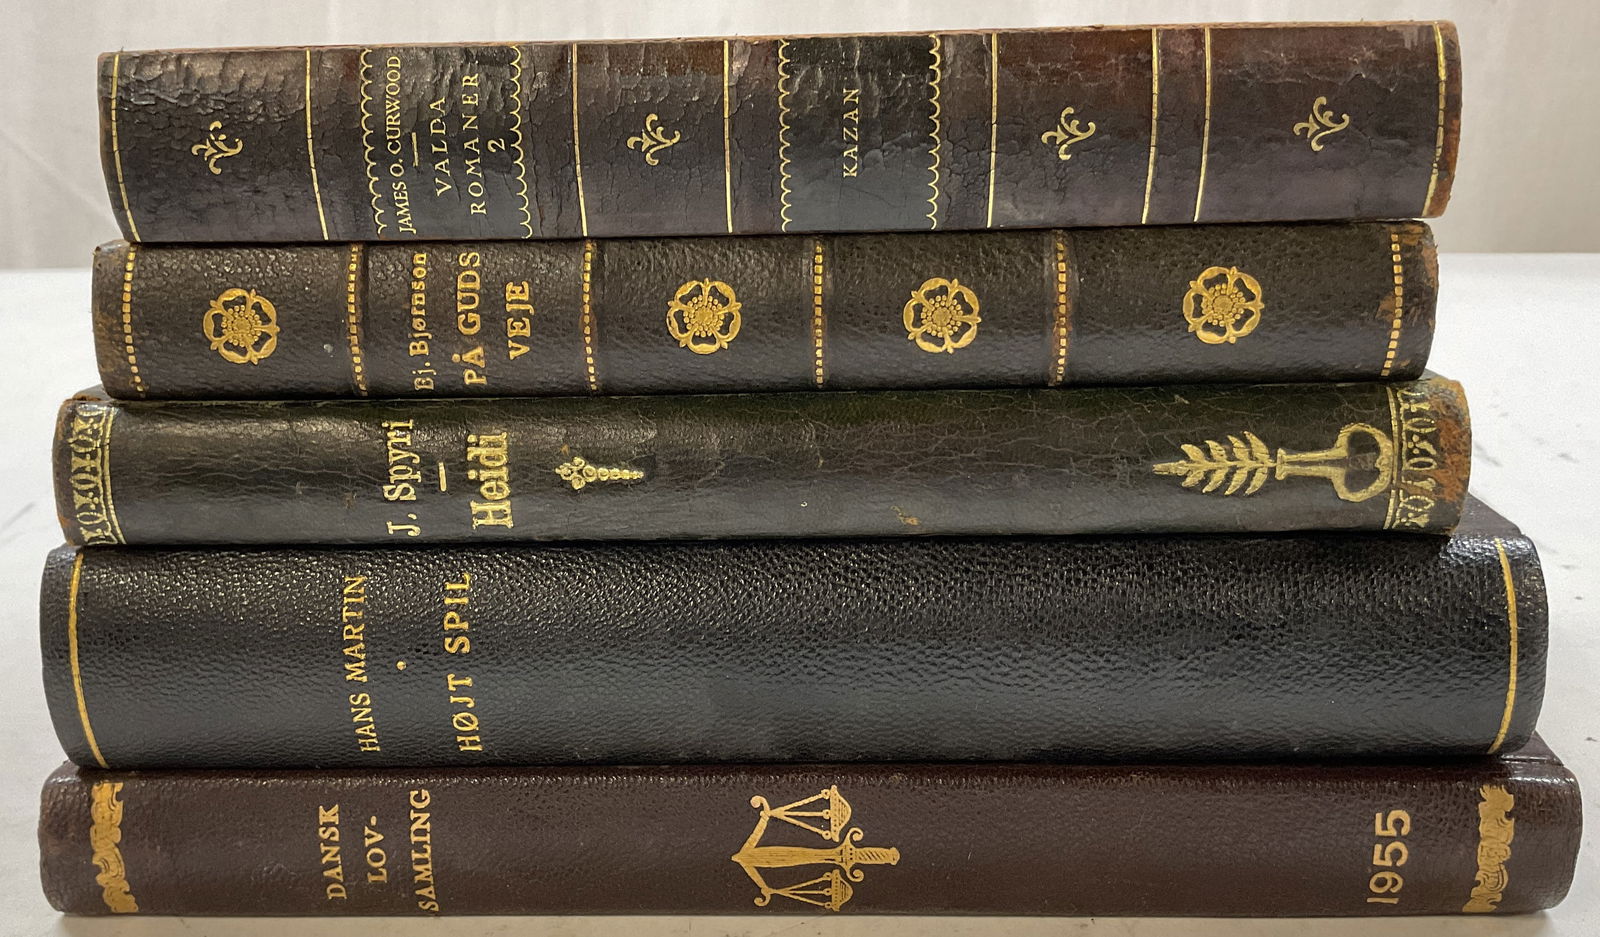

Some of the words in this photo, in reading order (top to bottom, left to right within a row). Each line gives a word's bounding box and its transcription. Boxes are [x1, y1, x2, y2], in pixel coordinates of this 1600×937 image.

[386, 56, 401, 155] CURWOOD
[430, 97, 451, 196] VALDA
[462, 73, 487, 215] ROMANER
[487, 138, 505, 153] 2
[843, 88, 860, 178] KAZAN
[390, 159, 404, 177] O.
[392, 181, 416, 234] JAMES
[408, 253, 432, 356] Bjørnson
[457, 252, 481, 336] GUDS
[505, 281, 535, 360] VEJE
[414, 362, 437, 390] Bj.
[452, 346, 487, 385] PÅ
[467, 432, 514, 530] Heidi
[387, 513, 421, 536] J.
[342, 575, 368, 683] MARTIN
[443, 572, 472, 654] SPIL
[349, 692, 381, 752] HANS
[447, 673, 483, 751] HØJT
[319, 804, 347, 899] DANSK
[364, 815, 387, 883] LOV-
[409, 789, 439, 912] SAMLING
[1367, 810, 1411, 904] 1955
